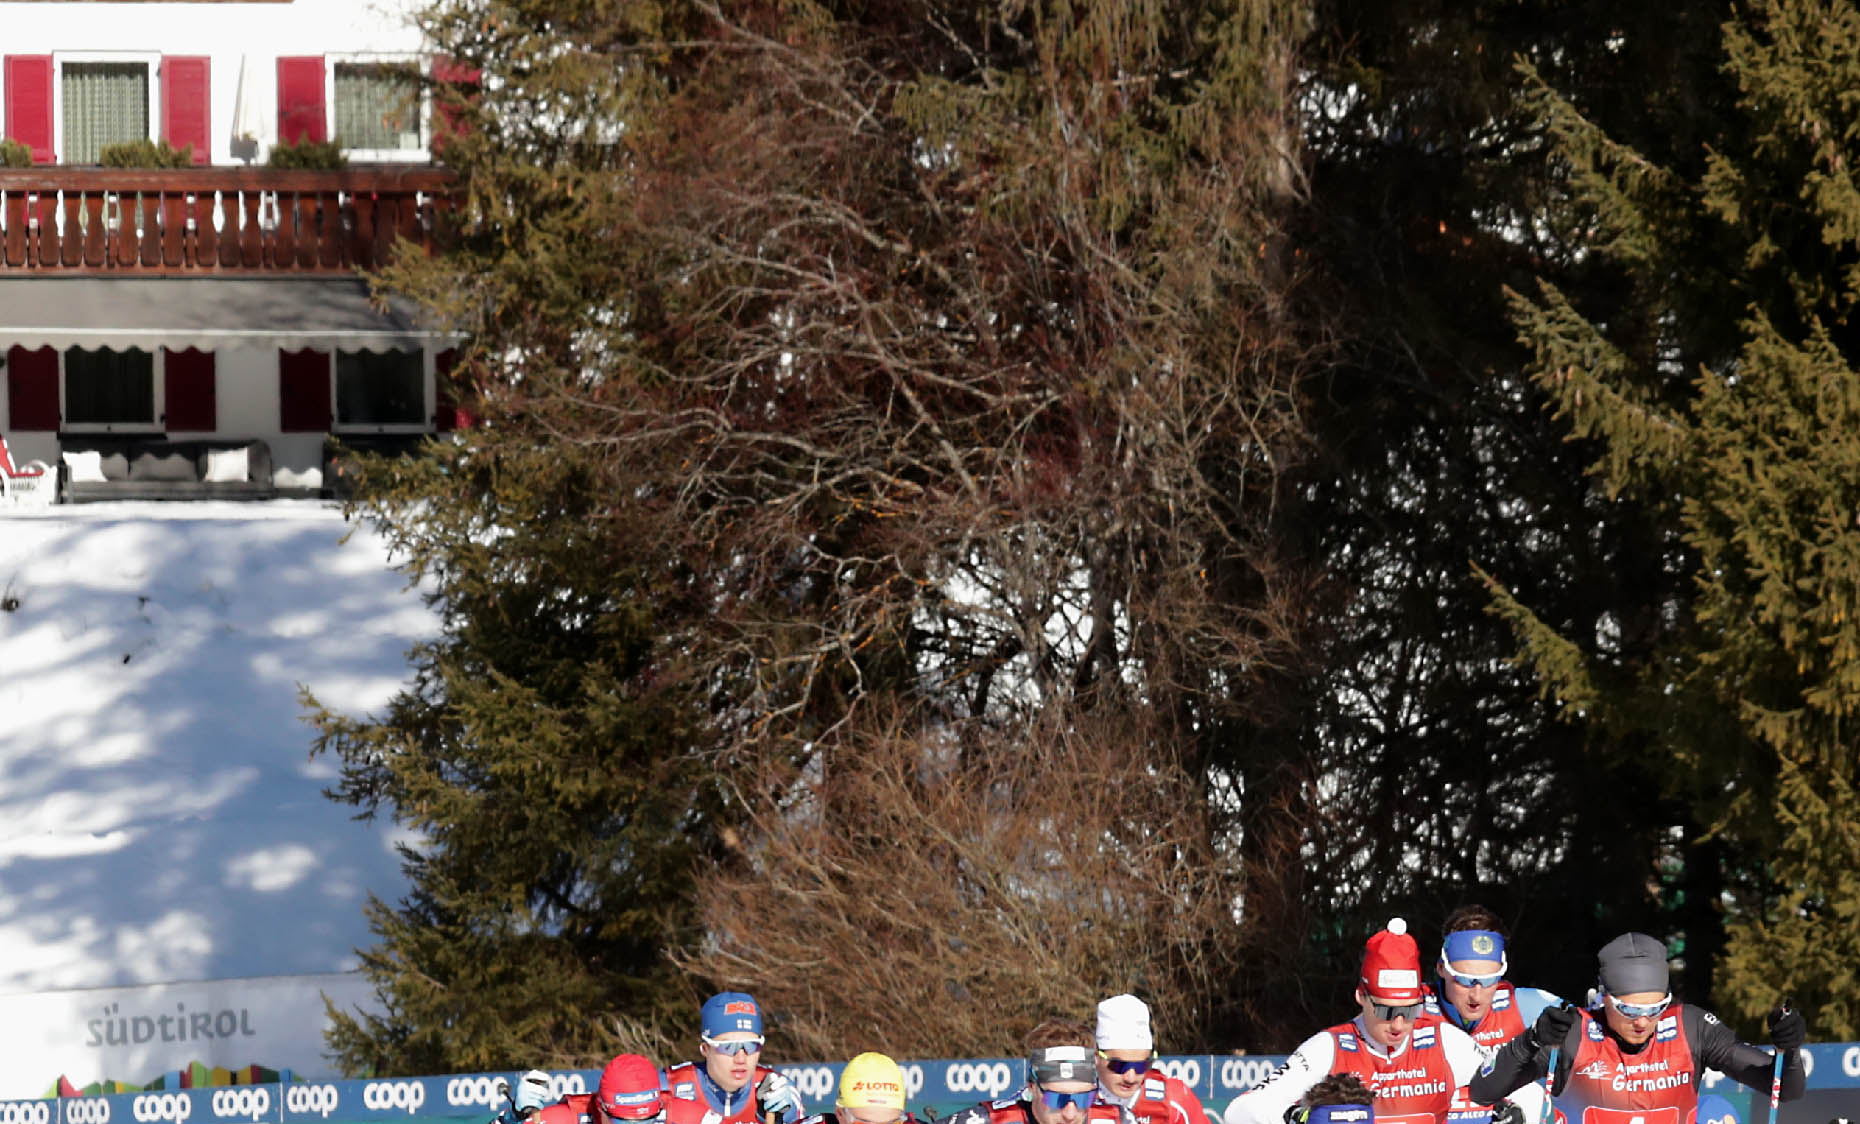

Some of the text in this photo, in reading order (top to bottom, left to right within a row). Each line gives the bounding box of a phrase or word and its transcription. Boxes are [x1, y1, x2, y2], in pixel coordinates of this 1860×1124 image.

[946, 1063, 1011, 1098] coop
[1371, 1067, 1427, 1082] Apparthotel
[1612, 1071, 1690, 1092] Germania
[212, 1088, 270, 1122] coop
[287, 1084, 338, 1118] coop
[363, 1080, 425, 1114] coop
[447, 1076, 509, 1111] coop
